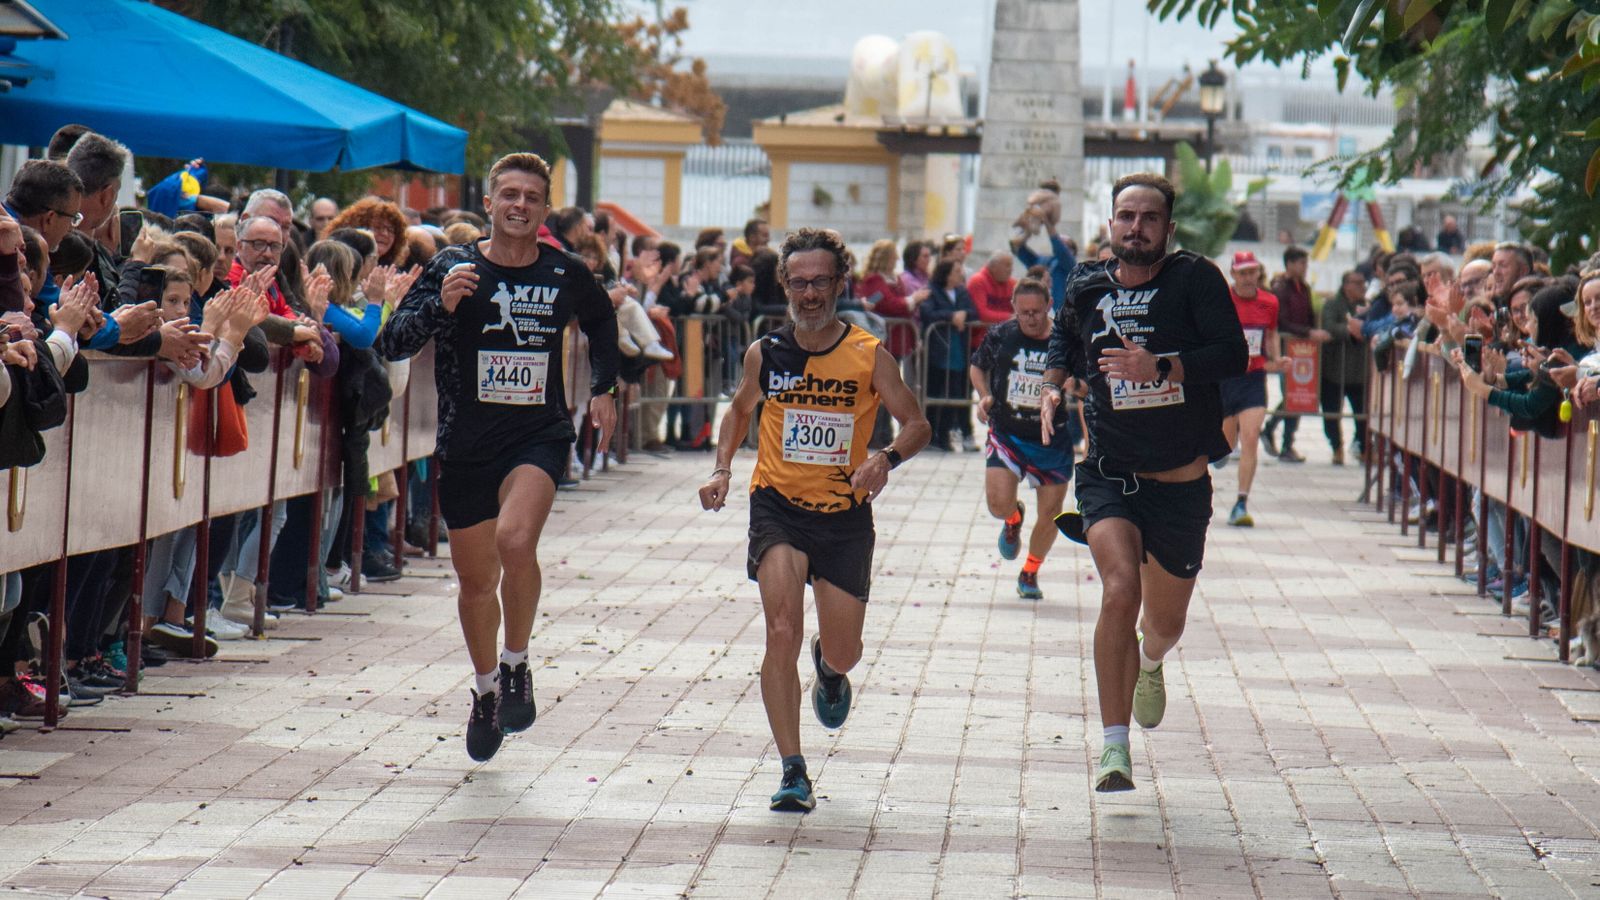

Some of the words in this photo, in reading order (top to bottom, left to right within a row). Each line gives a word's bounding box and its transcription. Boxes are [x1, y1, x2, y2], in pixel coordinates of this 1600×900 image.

[513, 285, 559, 303] XIV
[1116, 288, 1159, 305] XIV
[511, 301, 550, 310] CARRERA
[1113, 304, 1145, 312] CARRERA
[511, 307, 553, 316] ESTRECHO
[1113, 309, 1148, 317] ESTRECHO
[518, 320, 540, 328] PEPE
[518, 325, 557, 334] SERRANO
[1121, 326, 1155, 334] SERRANO
[490, 355, 513, 366] XIV
[495, 365, 532, 387] 440
[768, 370, 858, 394] bichos
[767, 390, 856, 407] runners
[796, 413, 818, 425] XIV
[799, 425, 836, 448] 300
